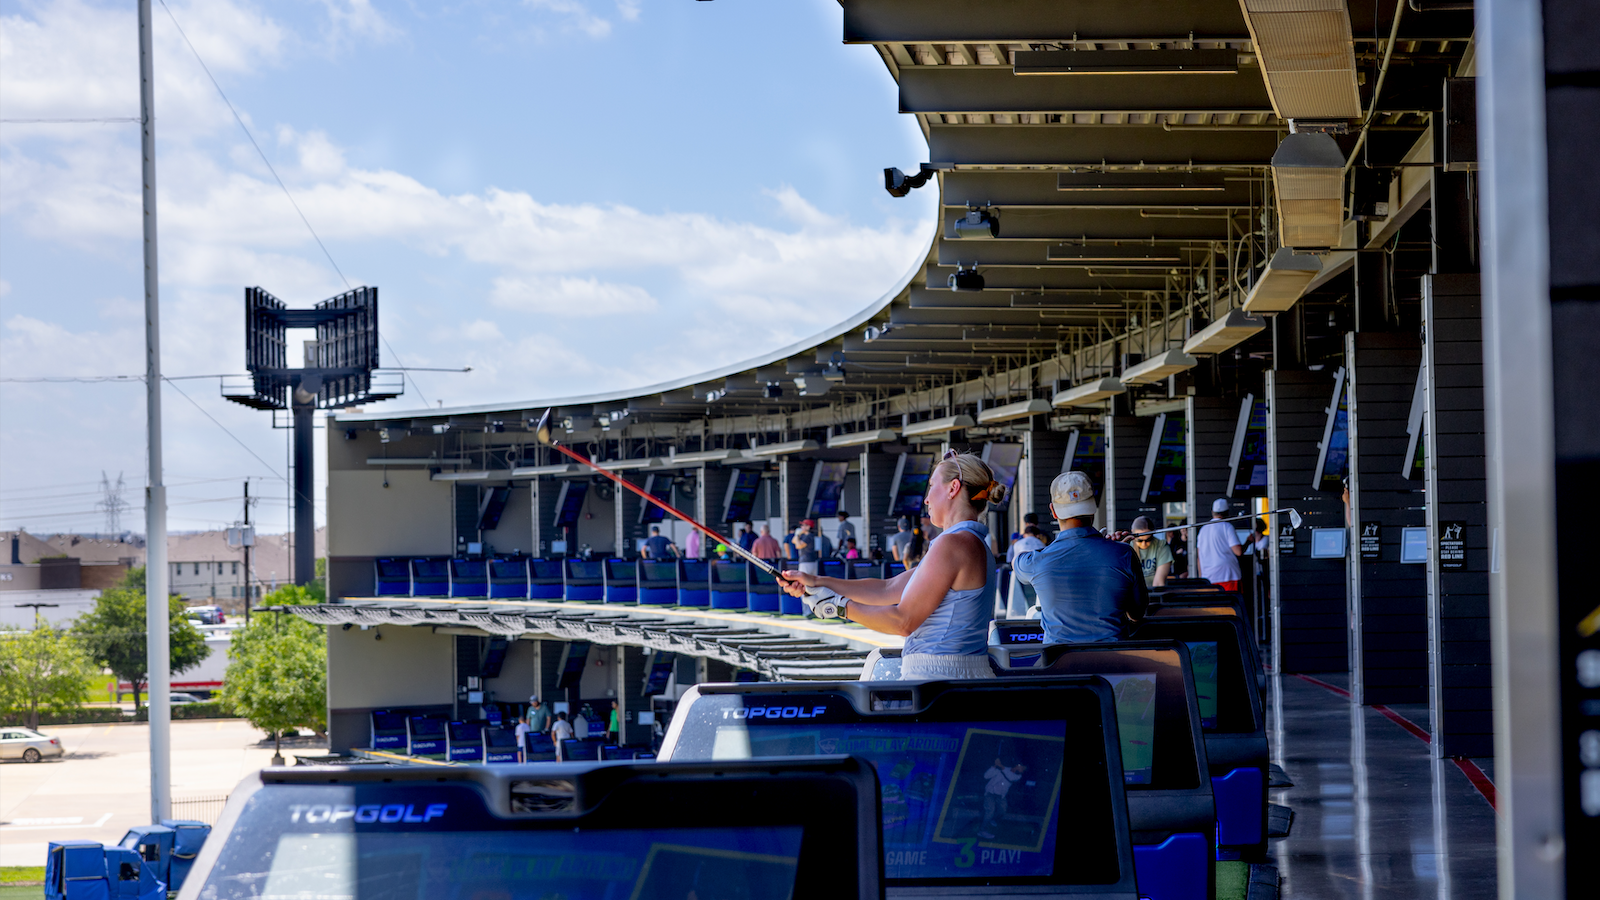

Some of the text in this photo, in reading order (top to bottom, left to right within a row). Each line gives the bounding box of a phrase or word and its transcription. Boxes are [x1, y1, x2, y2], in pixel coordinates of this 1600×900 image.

[720, 706, 827, 719] TOPGOLF
[875, 738, 906, 752] PLAY
[907, 738, 958, 752] AROUND
[288, 804, 448, 824] TOPGOLF
[886, 838, 1022, 868] GAME 3 PLAY!
